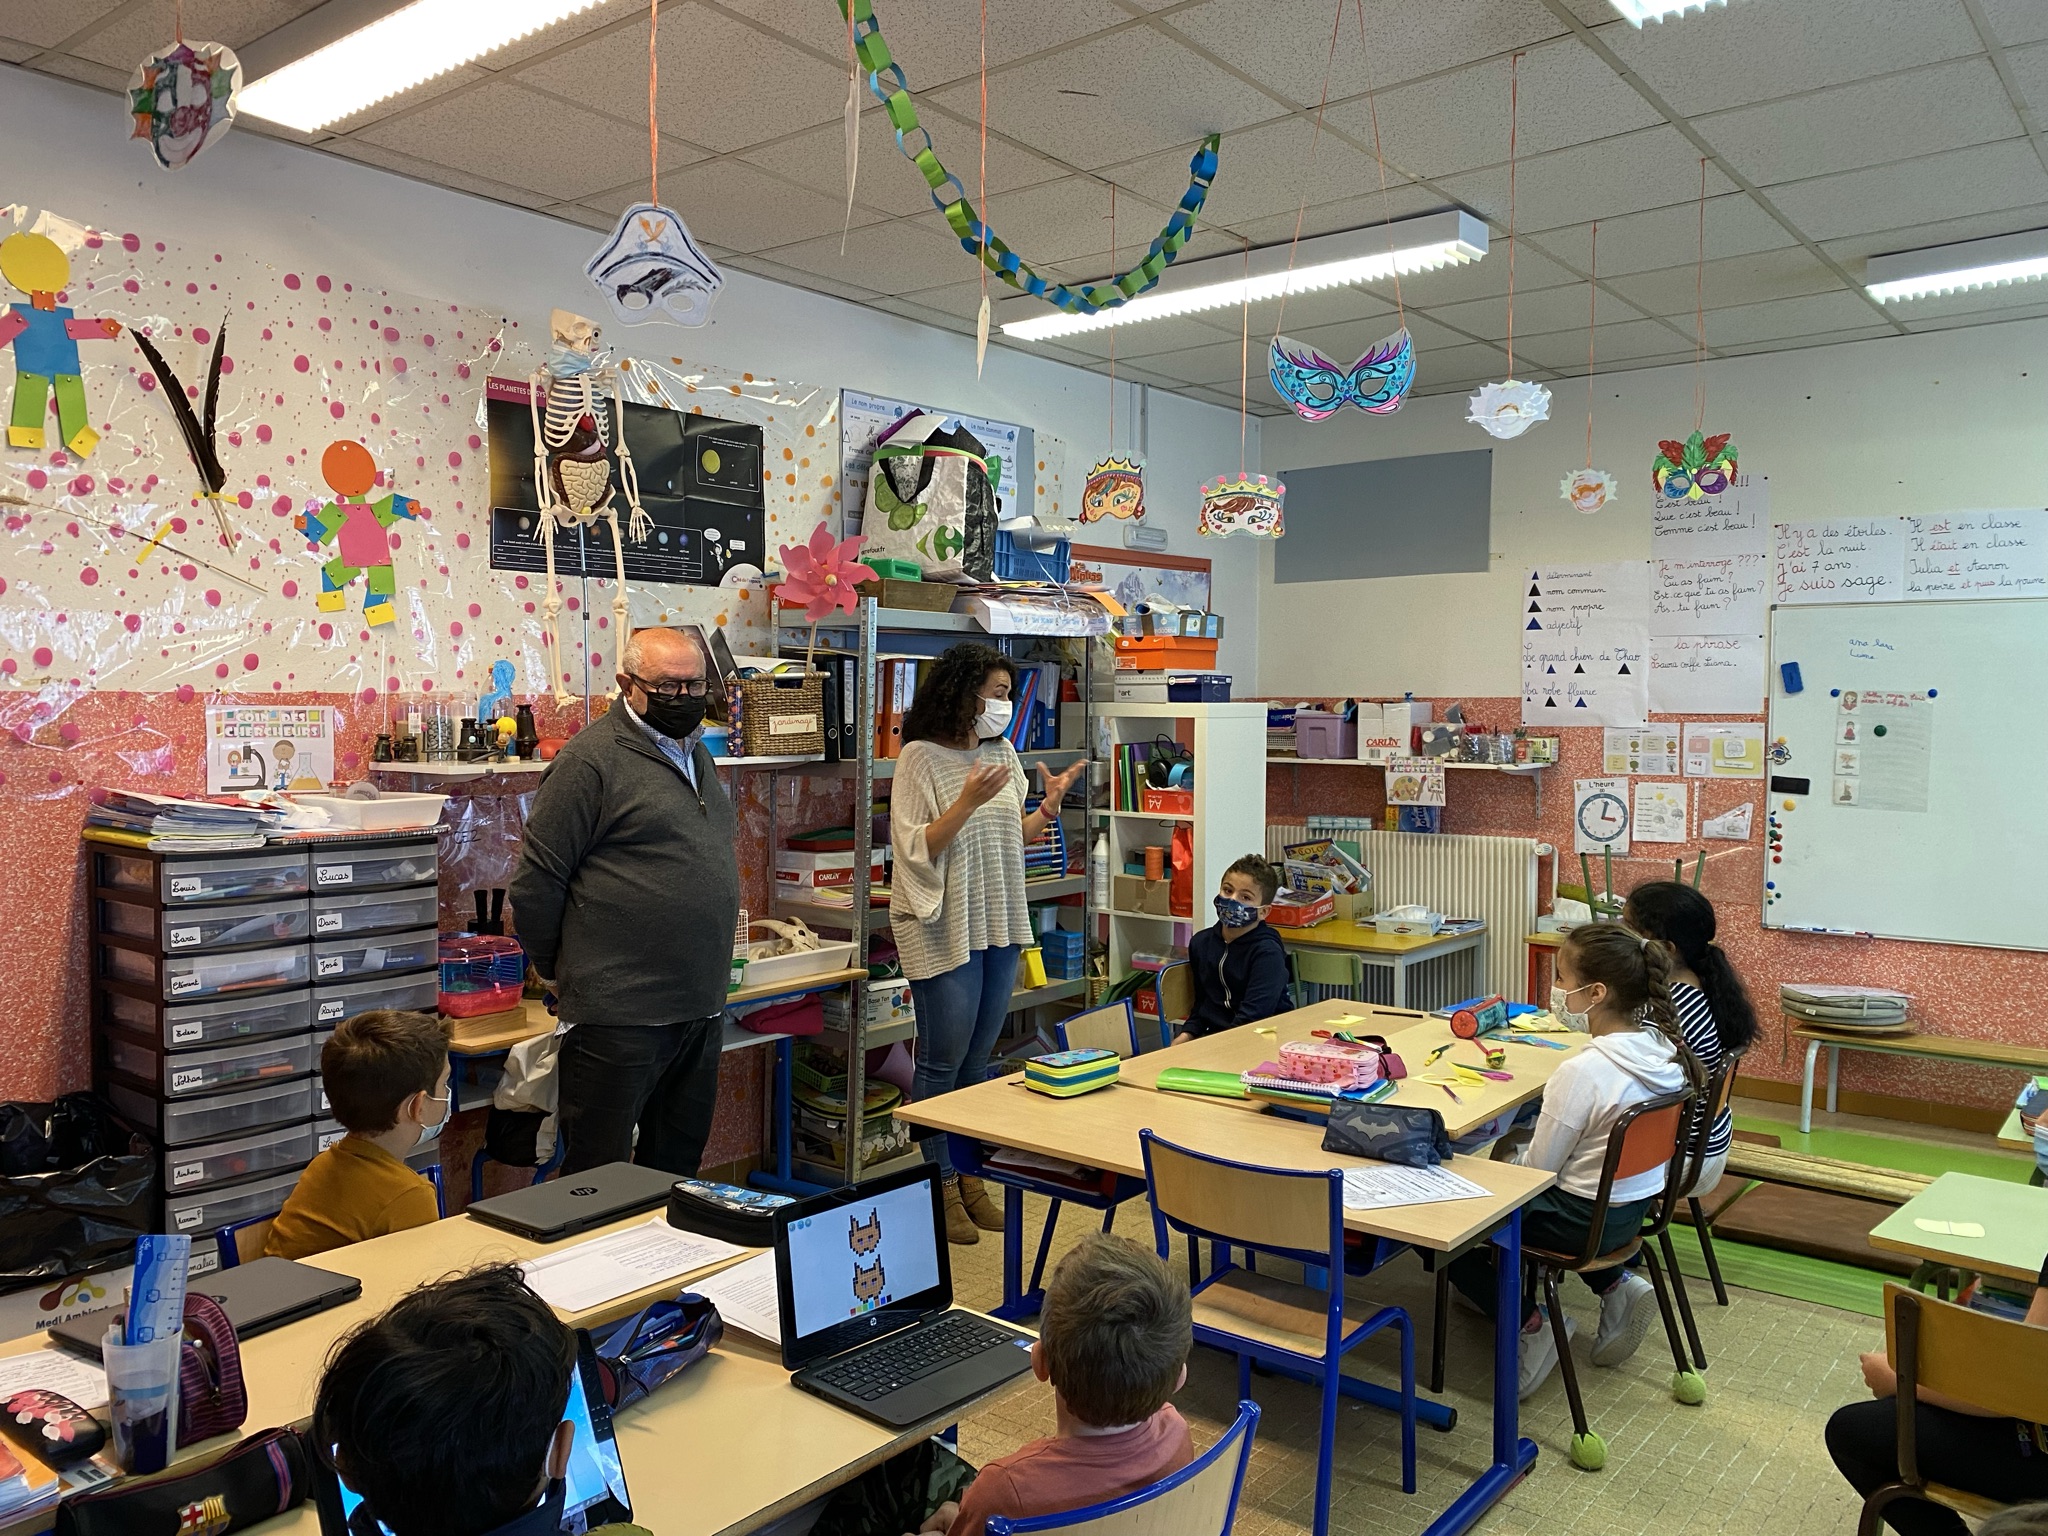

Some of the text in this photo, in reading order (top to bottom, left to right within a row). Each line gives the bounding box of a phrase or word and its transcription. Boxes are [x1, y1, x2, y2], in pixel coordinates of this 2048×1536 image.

[488, 382, 499, 390] LES
[499, 384, 527, 395] PLANETES
[851, 398, 886, 411] Le nom propre
[1654, 500, 1740, 521] Que c'est beau !
[1654, 513, 1755, 537] Comme c'est beau !
[1930, 519, 1951, 531] est
[1957, 522, 1975, 530] en
[1792, 530, 1803, 548] y
[1807, 528, 1818, 538] a
[1822, 525, 1840, 538] des
[1776, 543, 1810, 560] C'est
[1817, 540, 1834, 556] la
[1930, 538, 1958, 551] était
[1962, 541, 1979, 550] en
[1659, 560, 1670, 578] Je
[1674, 558, 1733, 575] m'interroge
[1777, 560, 1807, 583] J'ai
[1811, 560, 1819, 573] 7
[1948, 561, 1960, 573] et
[1967, 558, 2010, 573] Aaron
[1546, 569, 1593, 580] déterminant
[1663, 575, 1680, 588] Tu
[1697, 573, 1724, 590] faim
[1728, 571, 1734, 583] ?
[1546, 587, 1607, 596] nom commun
[1685, 591, 1701, 603] que
[1704, 587, 1716, 596] tu
[1732, 583, 1756, 601] faim
[1757, 580, 1765, 594] ?
[1777, 581, 1795, 602] Je
[1799, 576, 1836, 591] suis
[1907, 580, 1922, 592] la
[1925, 582, 1956, 596] poire
[1961, 579, 1971, 590] et
[1998, 575, 2013, 587] la
[2015, 576, 2046, 591] prune
[1570, 603, 1605, 618] propre
[1694, 600, 1721, 619] faim
[1723, 597, 1732, 610] ?
[1546, 616, 1583, 636] adjectif
[1674, 636, 1741, 658] la phrase
[1523, 642, 1537, 662] Le
[1539, 650, 1567, 672] grand
[1569, 646, 1594, 661] chien
[1599, 650, 1611, 661] de
[1522, 681, 1598, 703] Ma robe fleurie
[235, 711, 307, 722] COIN DES
[224, 725, 320, 738] CHERCHEURS
[772, 717, 814, 733] jardinage
[1366, 737, 1402, 747] CARLIN
[1148, 798, 1163, 811] A4
[1417, 806, 1427, 829] lotu
[318, 869, 350, 882] Lucas
[818, 871, 841, 881] CARLIN
[172, 881, 196, 893] Louis
[171, 932, 196, 944] Lara
[320, 958, 339, 973] José
[172, 978, 199, 991] Clément
[868, 997, 881, 1005] Base
[1141, 1000, 1155, 1011] A4
[175, 1028, 199, 1038] Eden
[187, 1257, 216, 1273] malia
[35, 1305, 109, 1330] Medi Ambi
